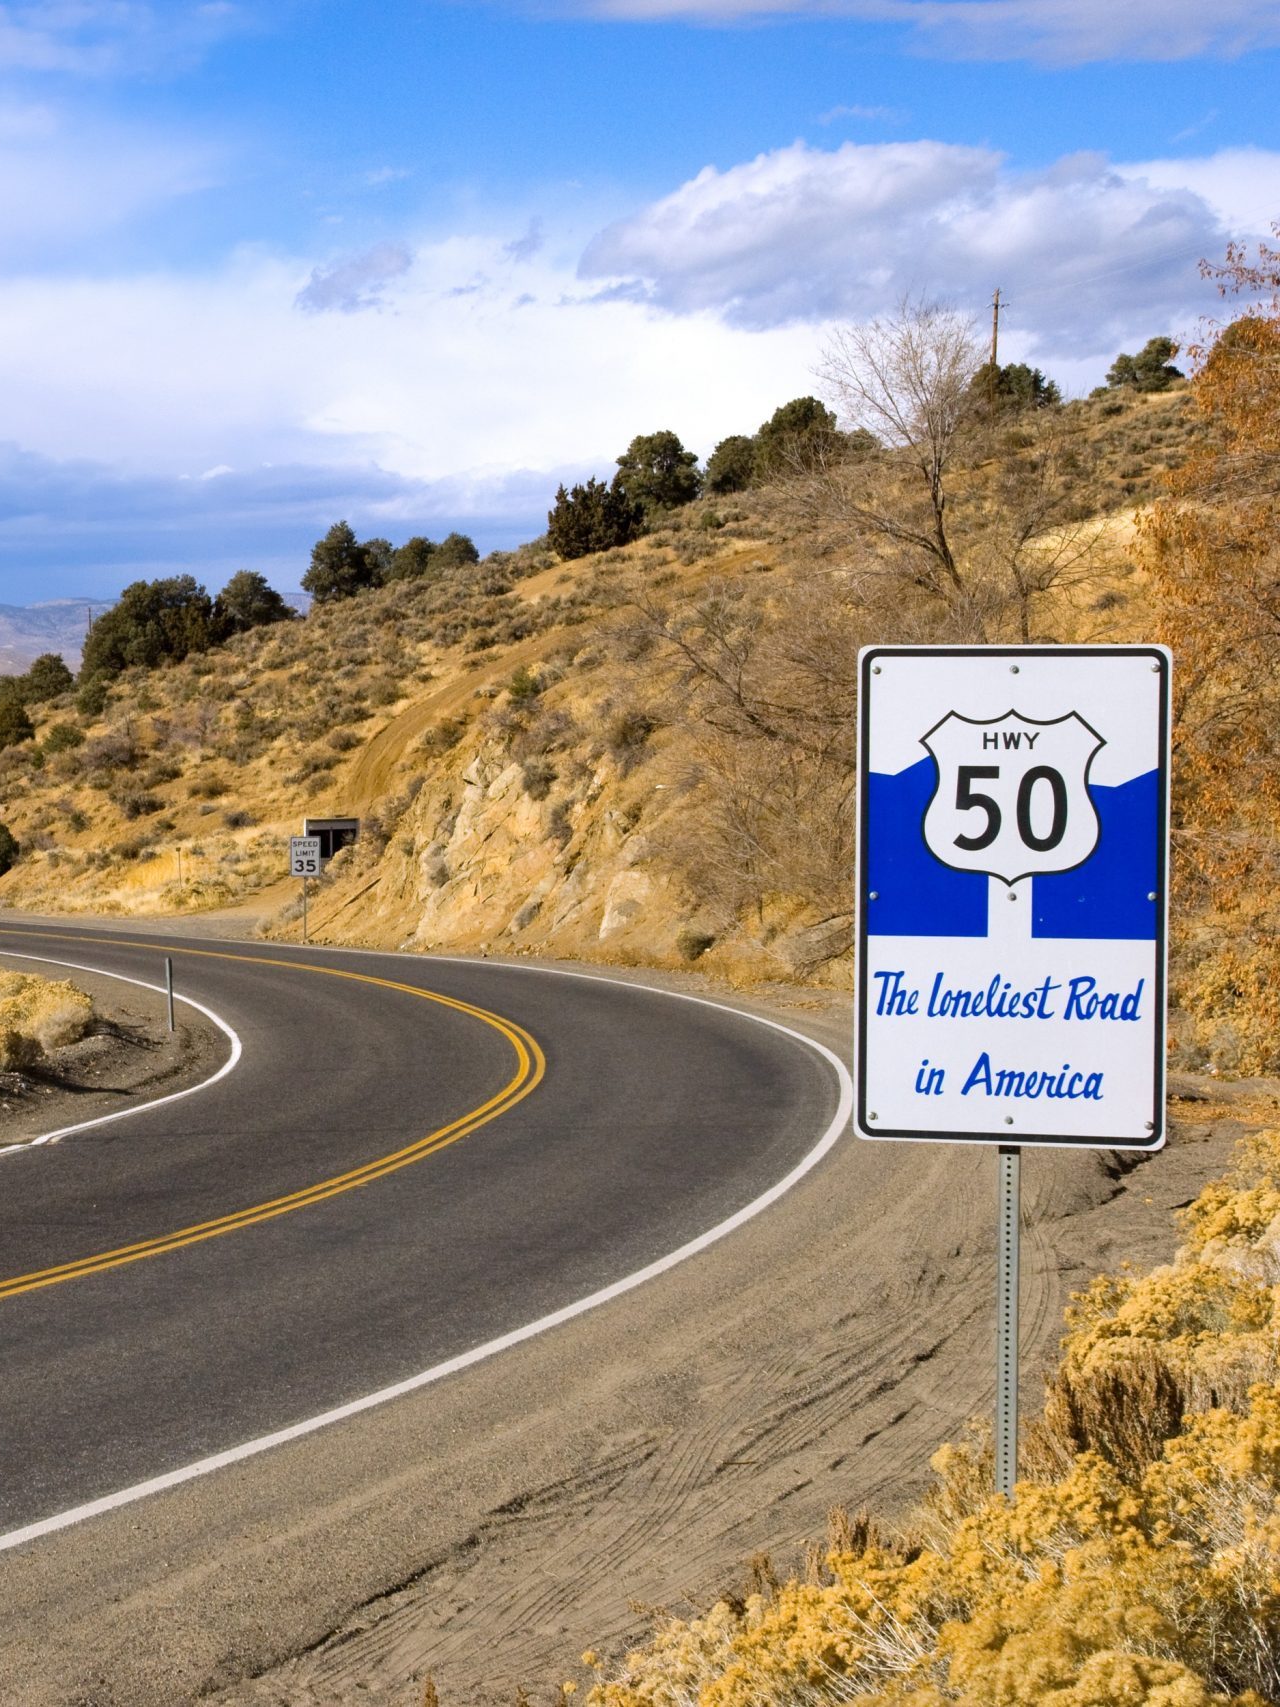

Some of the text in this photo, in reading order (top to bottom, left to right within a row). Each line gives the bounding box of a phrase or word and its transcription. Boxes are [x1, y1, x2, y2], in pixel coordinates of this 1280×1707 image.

[982, 732, 1040, 750] HWY
[952, 765, 1068, 852] 50
[292, 840, 318, 848] SPEED
[294, 859, 317, 873] 35
[873, 970, 920, 1017] The
[1062, 975, 1146, 1023] Road
[914, 1051, 1106, 1102] in America
